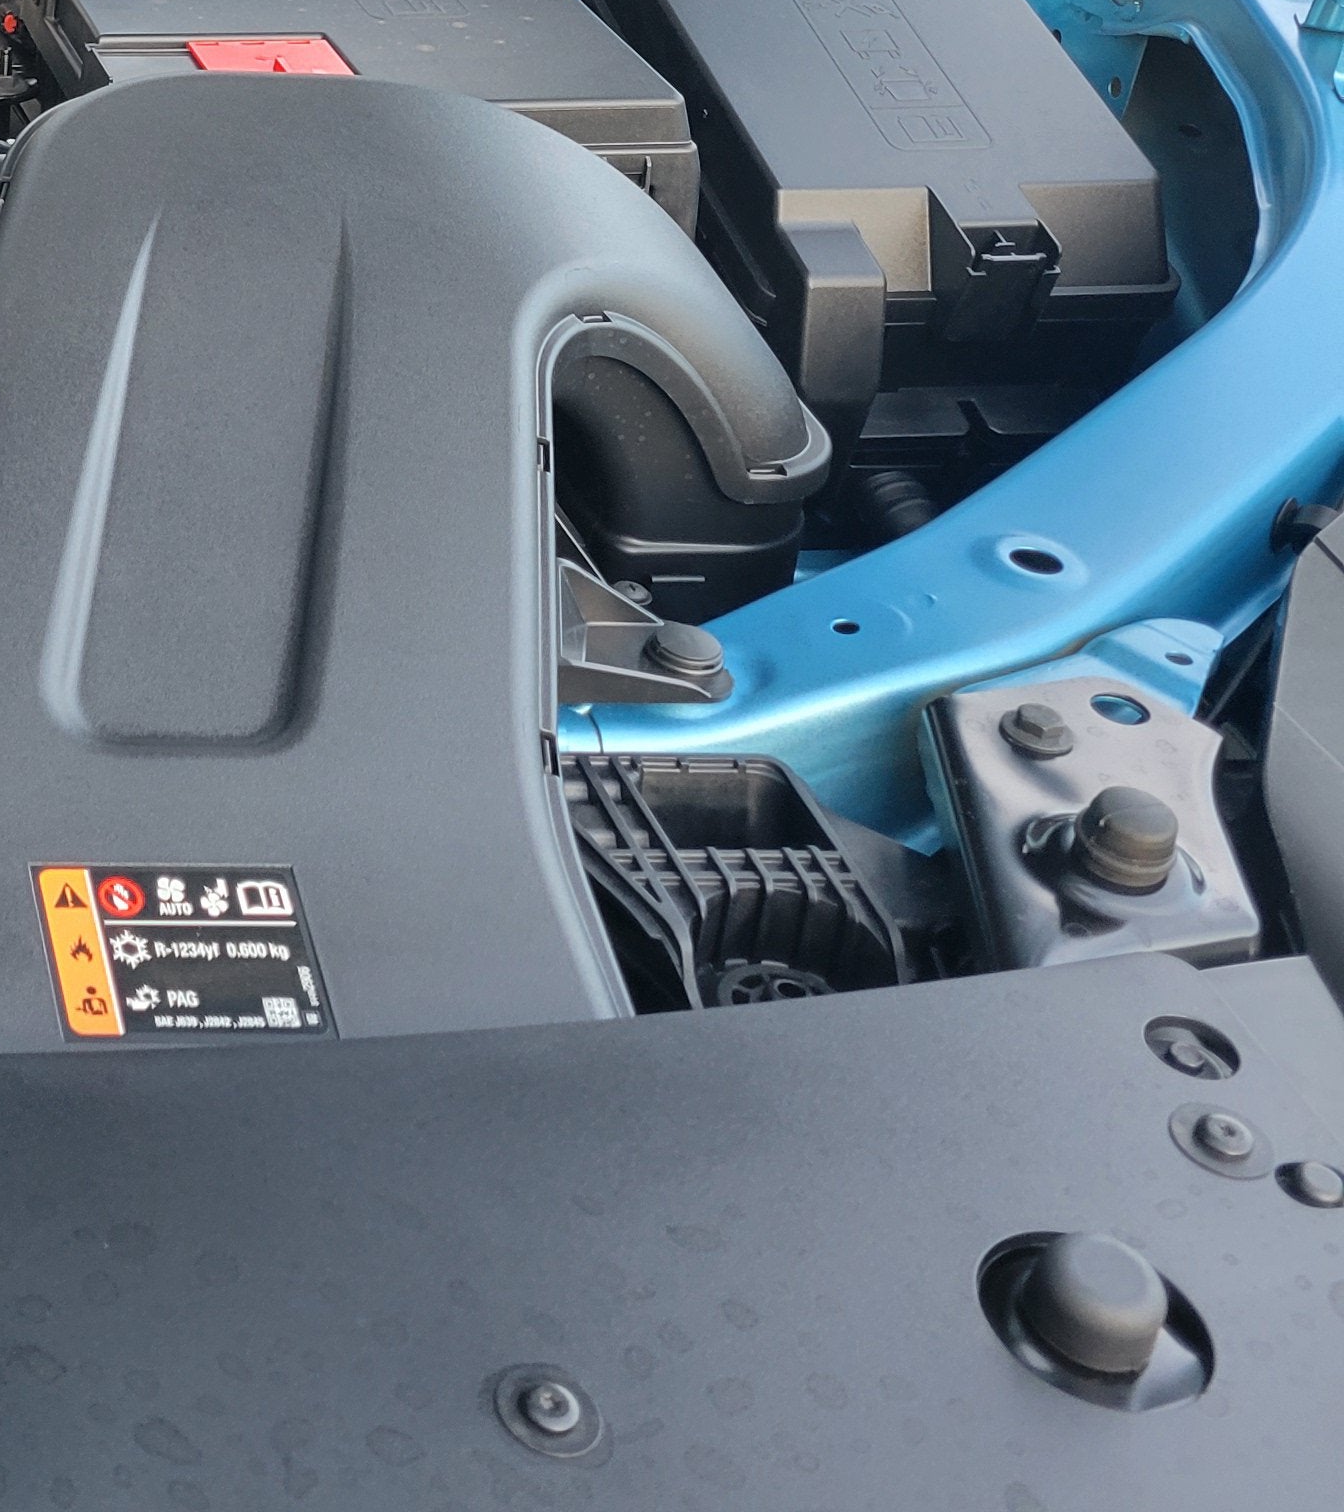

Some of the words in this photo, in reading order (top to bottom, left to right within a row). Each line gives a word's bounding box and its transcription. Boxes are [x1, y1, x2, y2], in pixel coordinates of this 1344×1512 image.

[160, 902, 194, 916] AUTO
[154, 942, 220, 962] R-1234yf
[226, 942, 267, 960] 0.600
[268, 942, 291, 962] kg
[166, 990, 200, 1009] PAG
